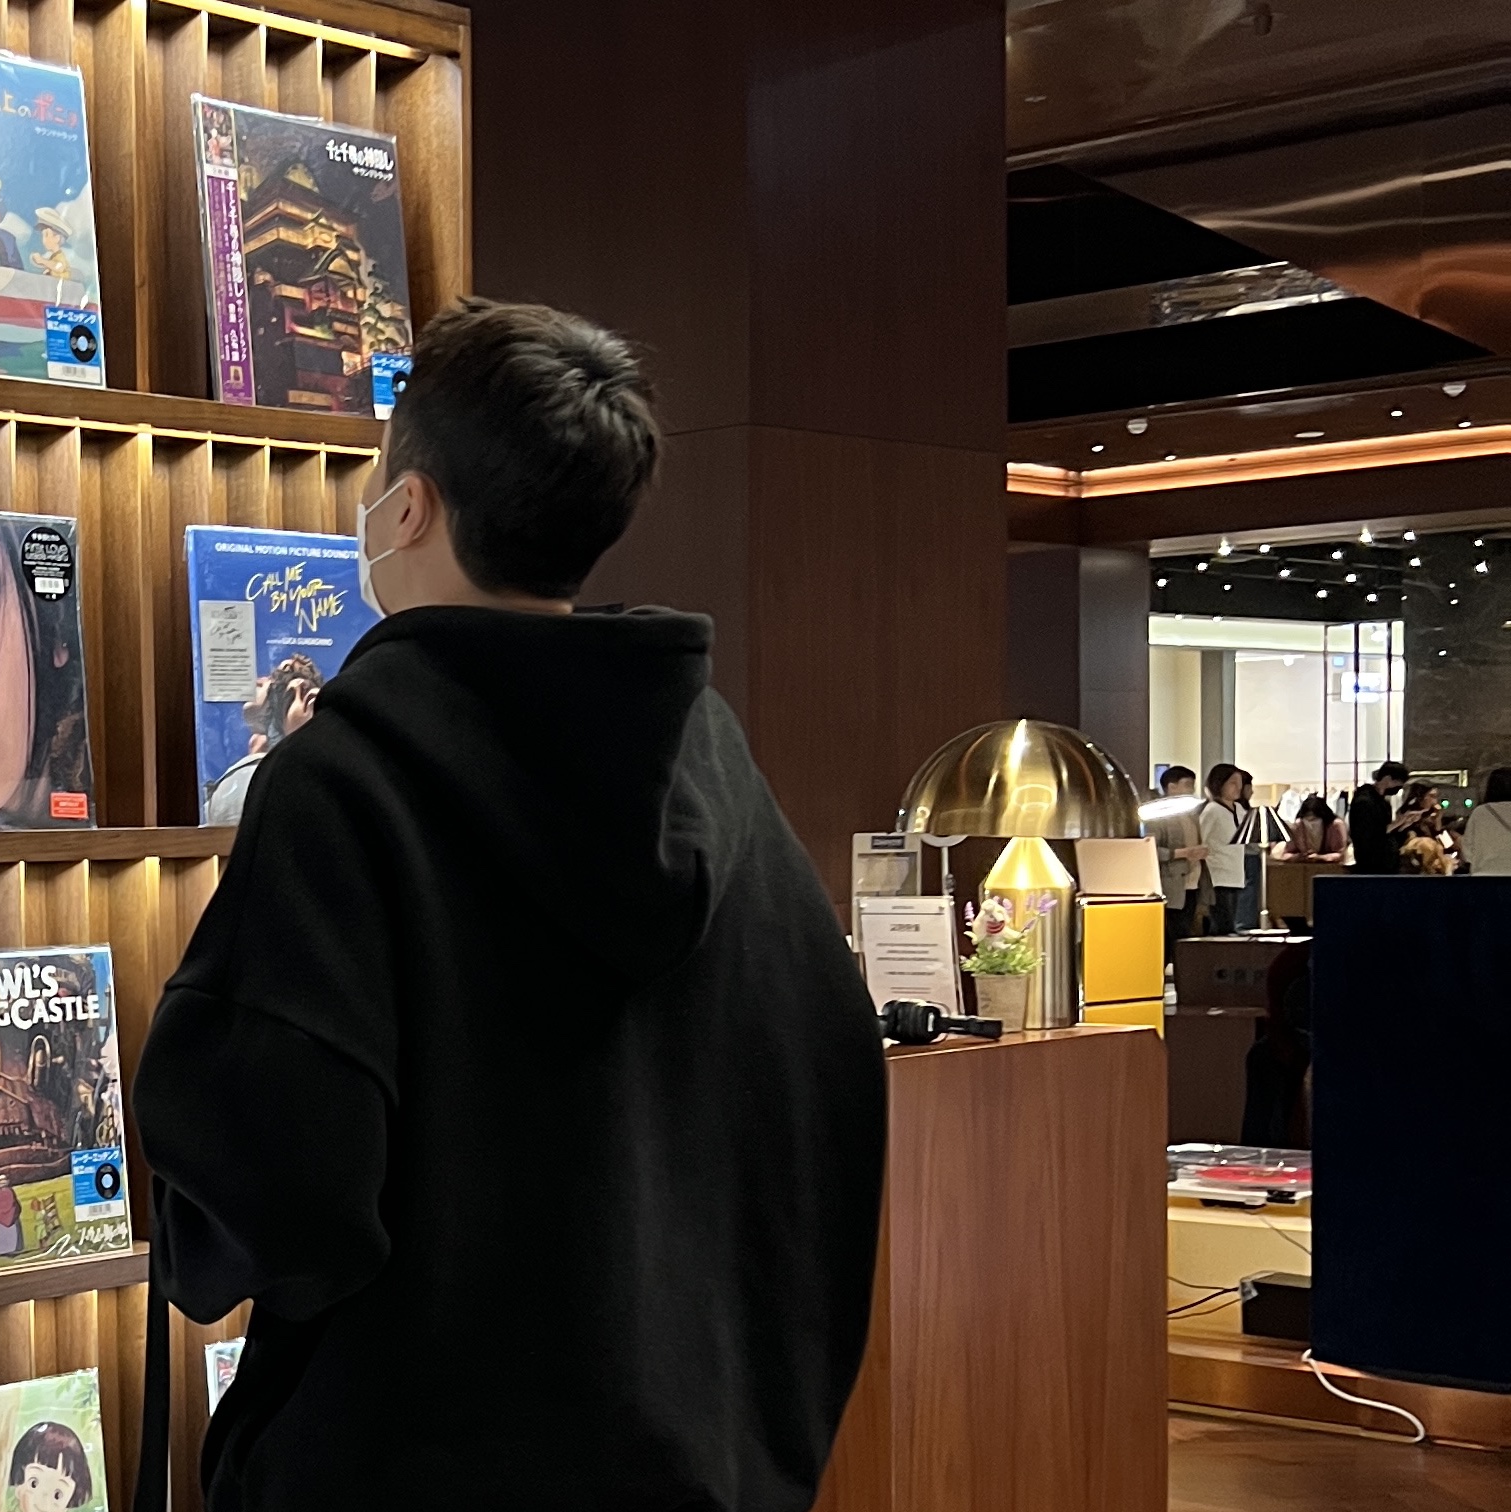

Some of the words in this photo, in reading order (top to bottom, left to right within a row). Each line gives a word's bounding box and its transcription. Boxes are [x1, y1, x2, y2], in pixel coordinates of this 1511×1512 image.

[215, 542, 254, 554] ORIGINAL
[255, 546, 288, 556] MOTION
[289, 547, 322, 558] PICTURE
[245, 572, 284, 602] CALL
[284, 561, 308, 592] ME
[270, 590, 288, 613] BY
[289, 577, 335, 617] YOUR
[298, 590, 349, 635] NAME
[10, 994, 101, 1030] CASTLE
